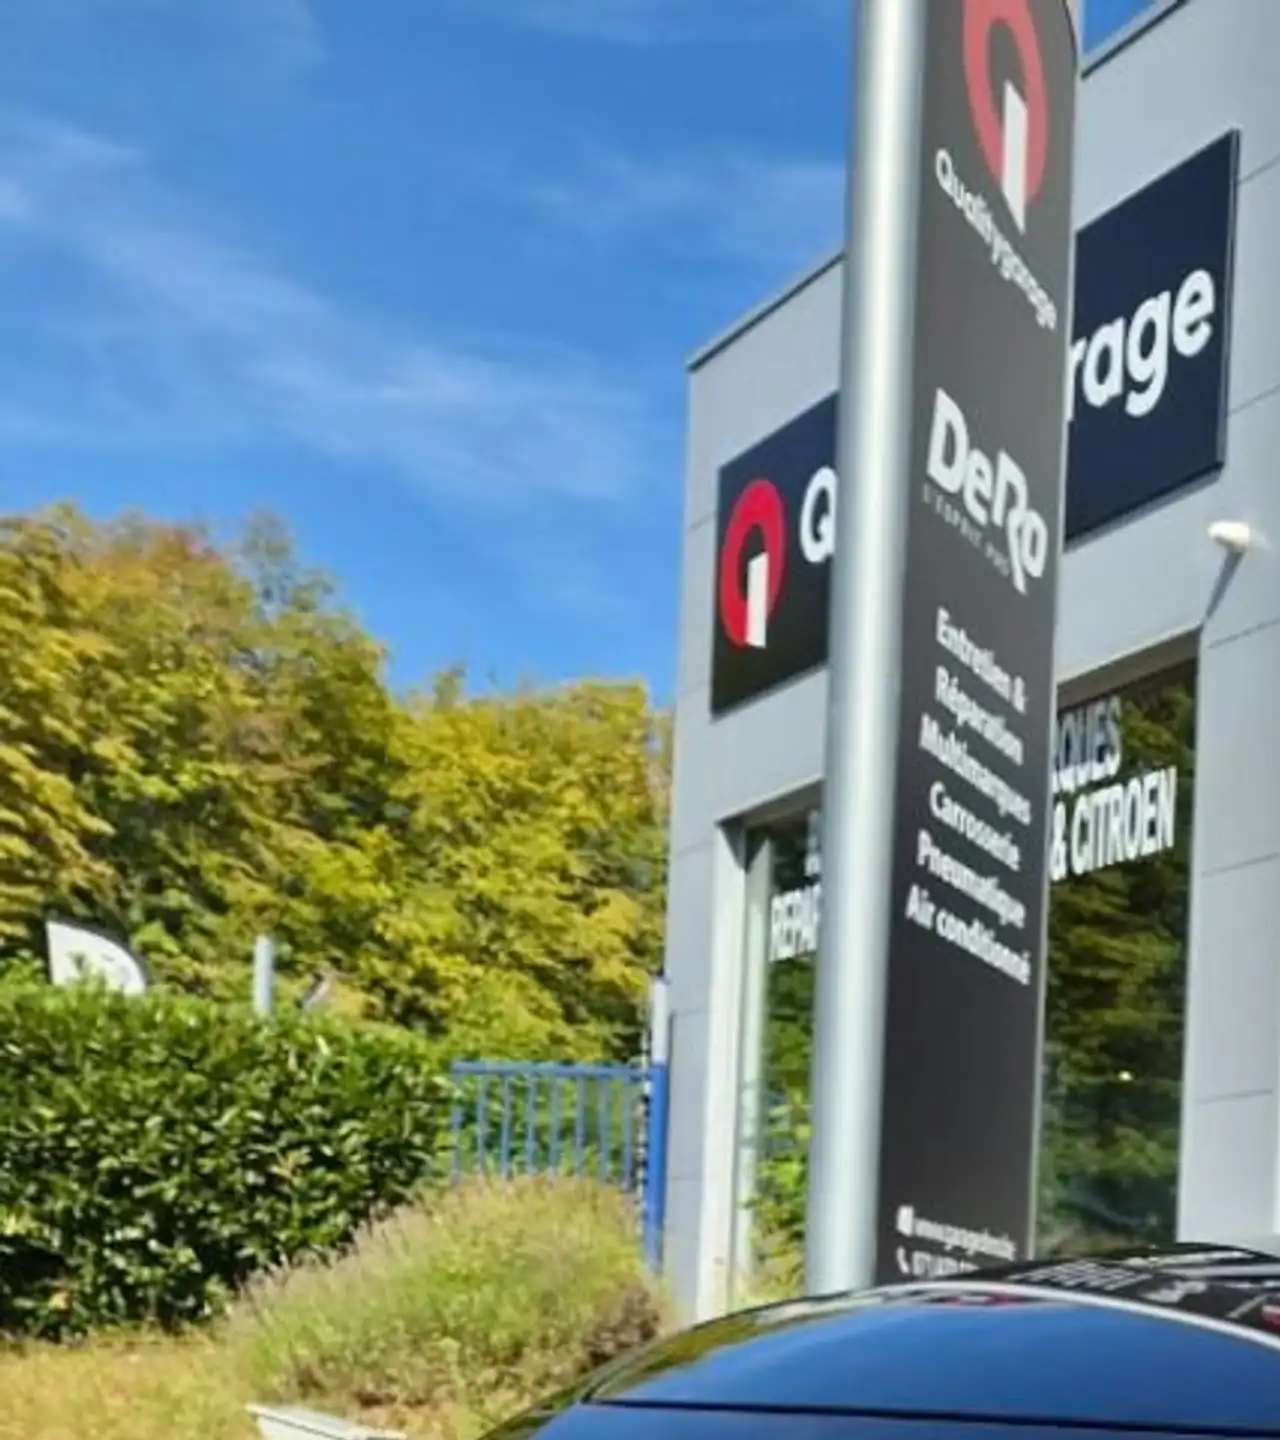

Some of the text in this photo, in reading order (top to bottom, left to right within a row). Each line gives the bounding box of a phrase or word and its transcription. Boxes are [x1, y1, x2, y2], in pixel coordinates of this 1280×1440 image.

[1052, 696, 1121, 795] QUES
[1071, 766, 1177, 875] CITROEN
[905, 884, 937, 930] Air
